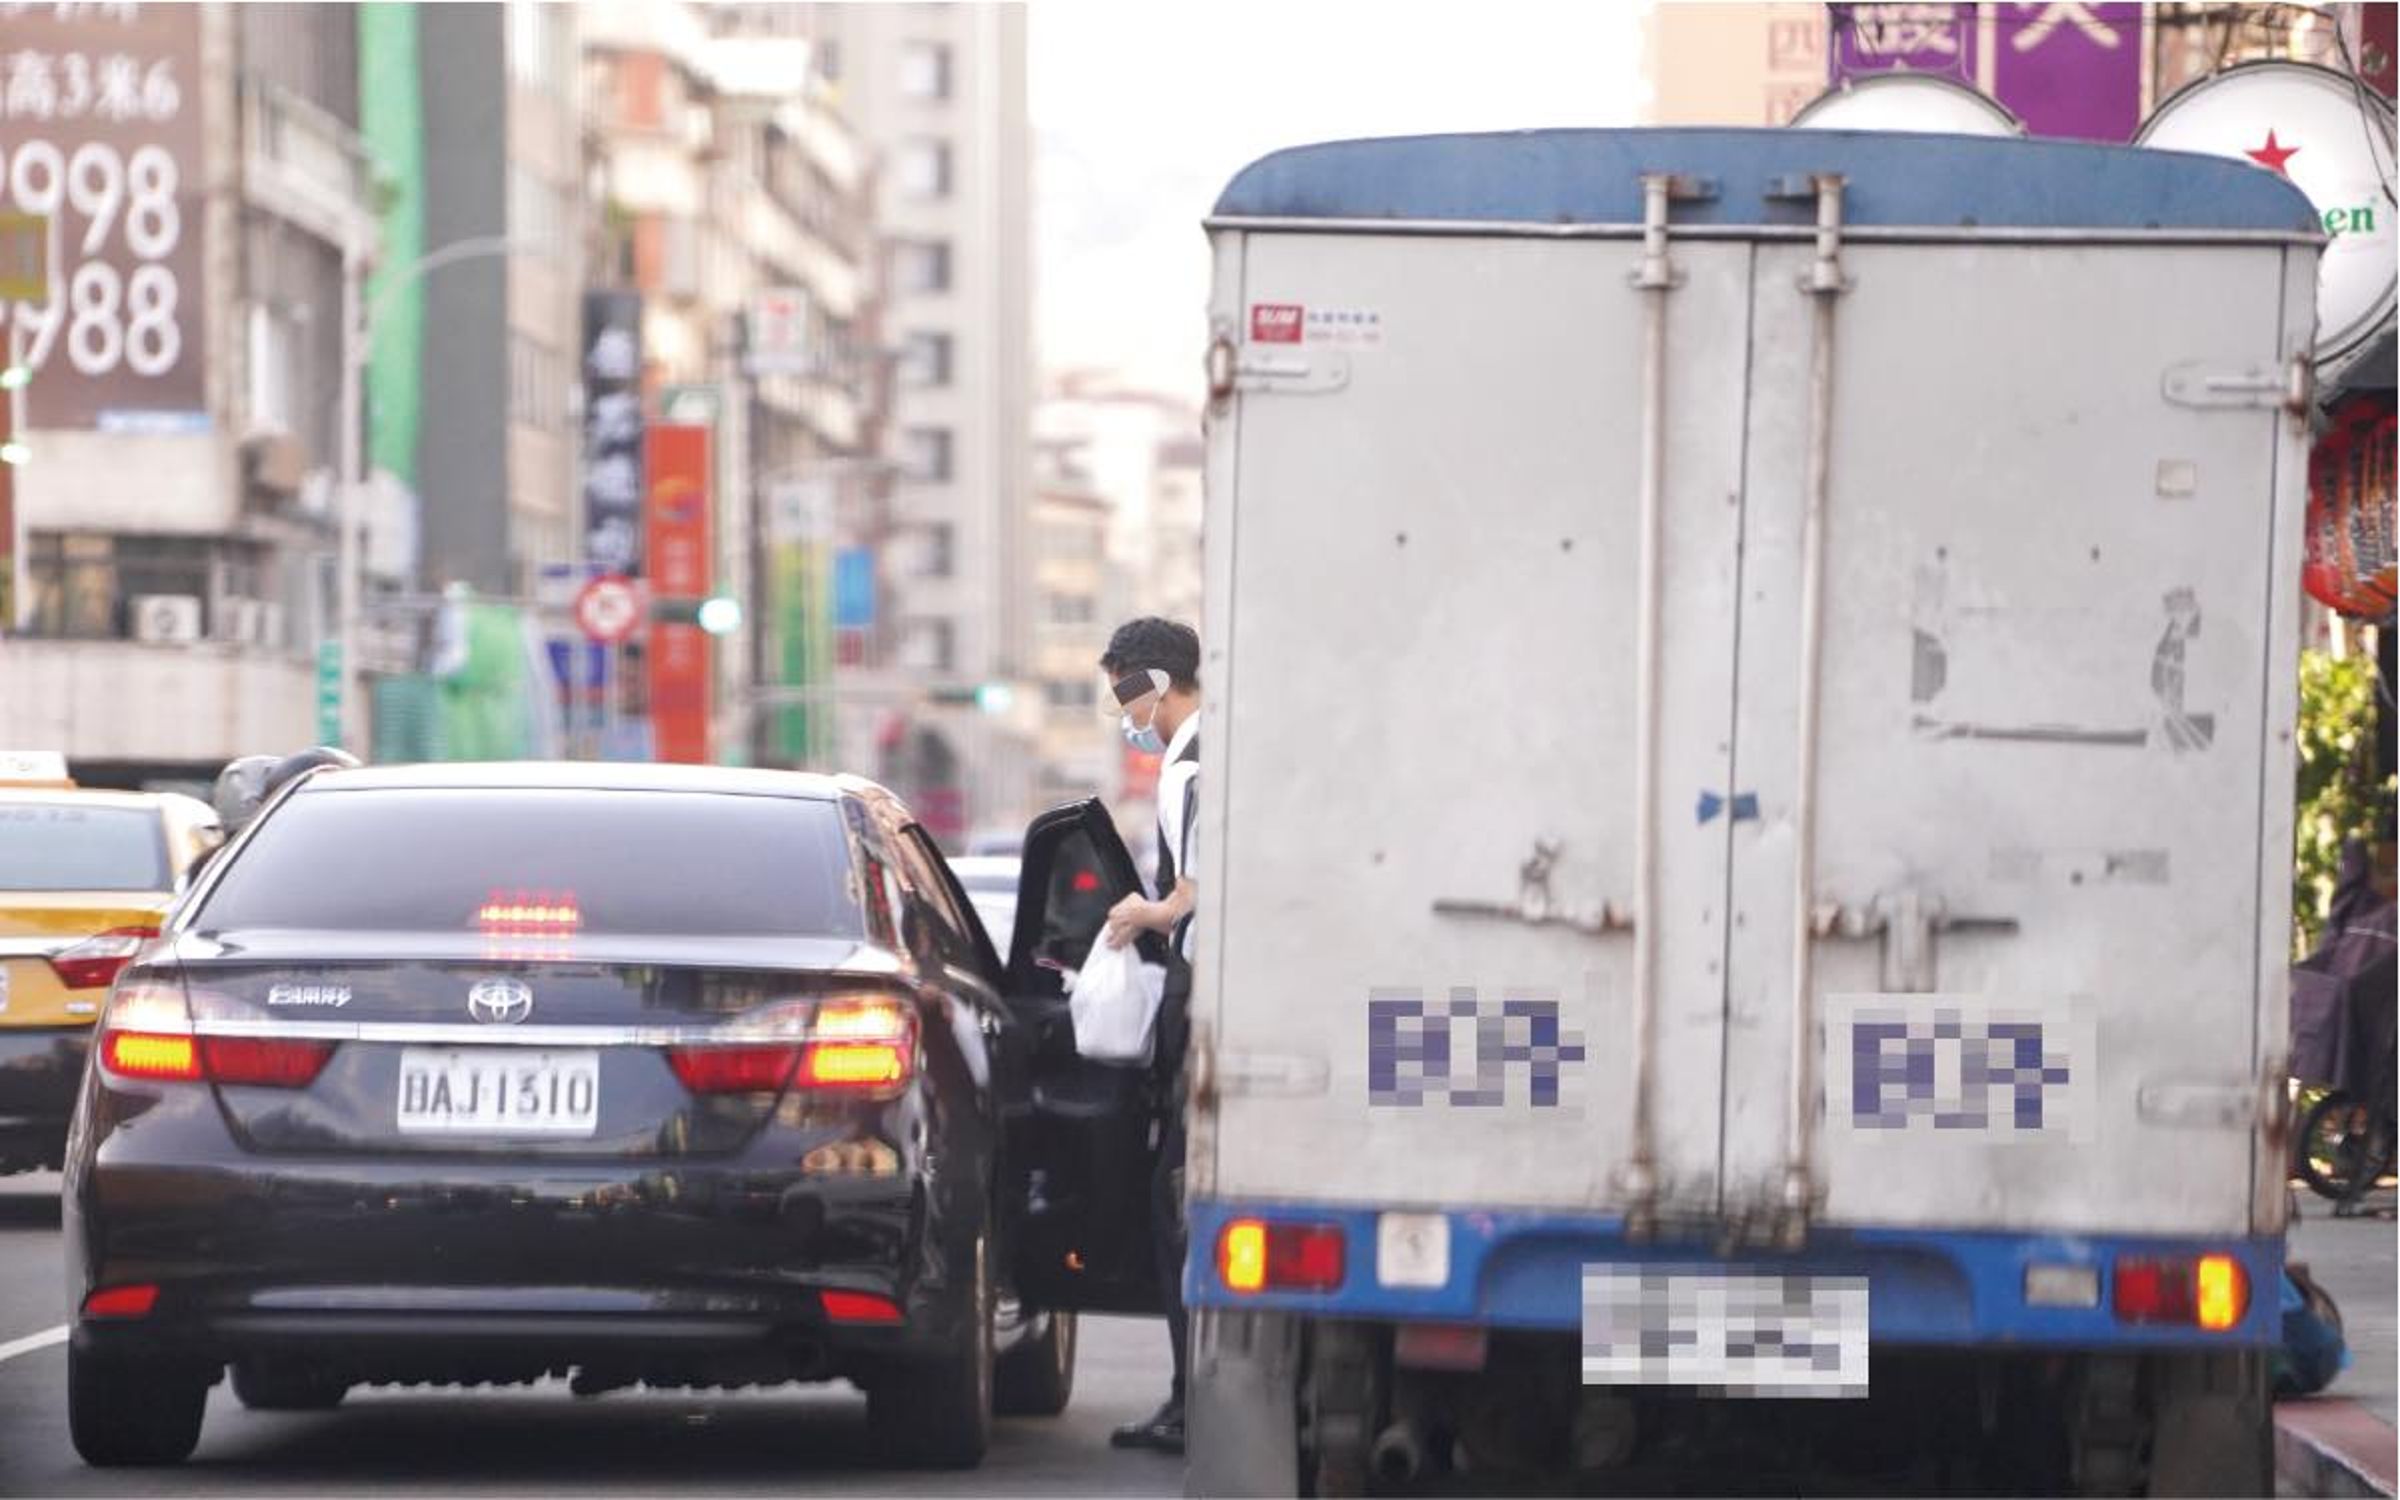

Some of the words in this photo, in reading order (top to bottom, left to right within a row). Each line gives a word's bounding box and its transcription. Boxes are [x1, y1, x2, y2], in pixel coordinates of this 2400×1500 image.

[0, 48, 182, 124] 高3米6
[0, 138, 181, 260] 998
[2324, 206, 2375, 235] en
[0, 260, 182, 376] 988
